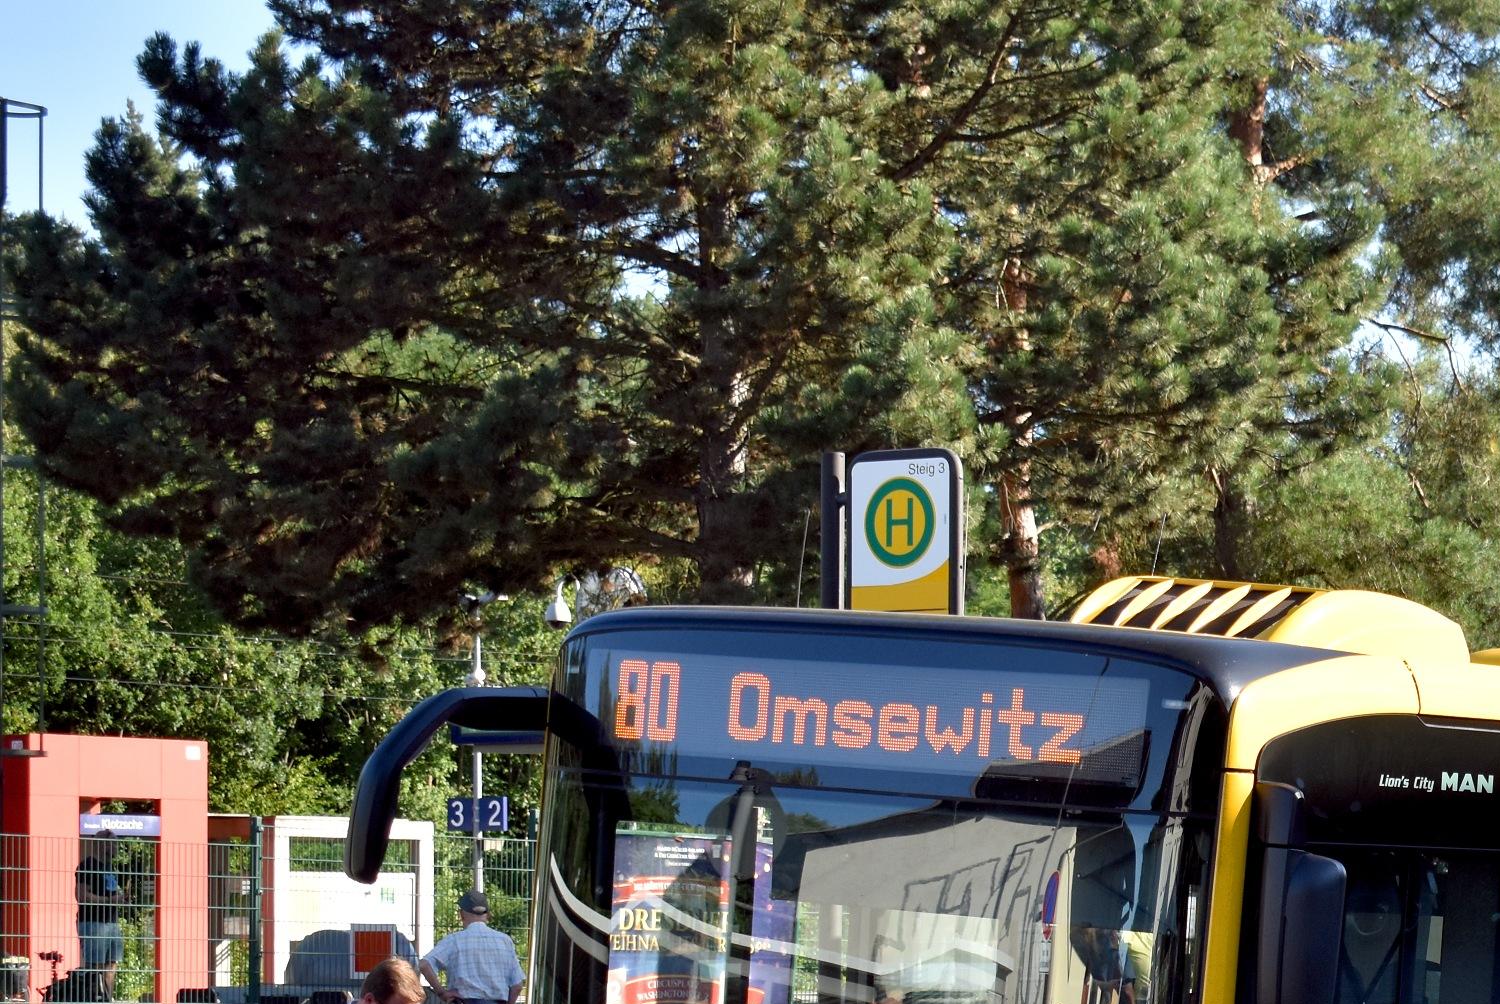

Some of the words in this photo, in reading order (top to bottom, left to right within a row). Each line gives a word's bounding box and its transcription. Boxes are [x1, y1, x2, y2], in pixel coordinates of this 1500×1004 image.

[908, 463, 935, 477] Steig
[938, 463, 945, 474] 3
[886, 498, 914, 547] H
[614, 659, 681, 742] 80
[727, 671, 1085, 764] Omsewitz
[1379, 774, 1409, 789] Lion's
[1413, 776, 1435, 792] City
[1441, 772, 1494, 794] MAN
[101, 819, 144, 829] Klotzsche
[451, 801, 464, 827] 3
[488, 800, 501, 826] 2
